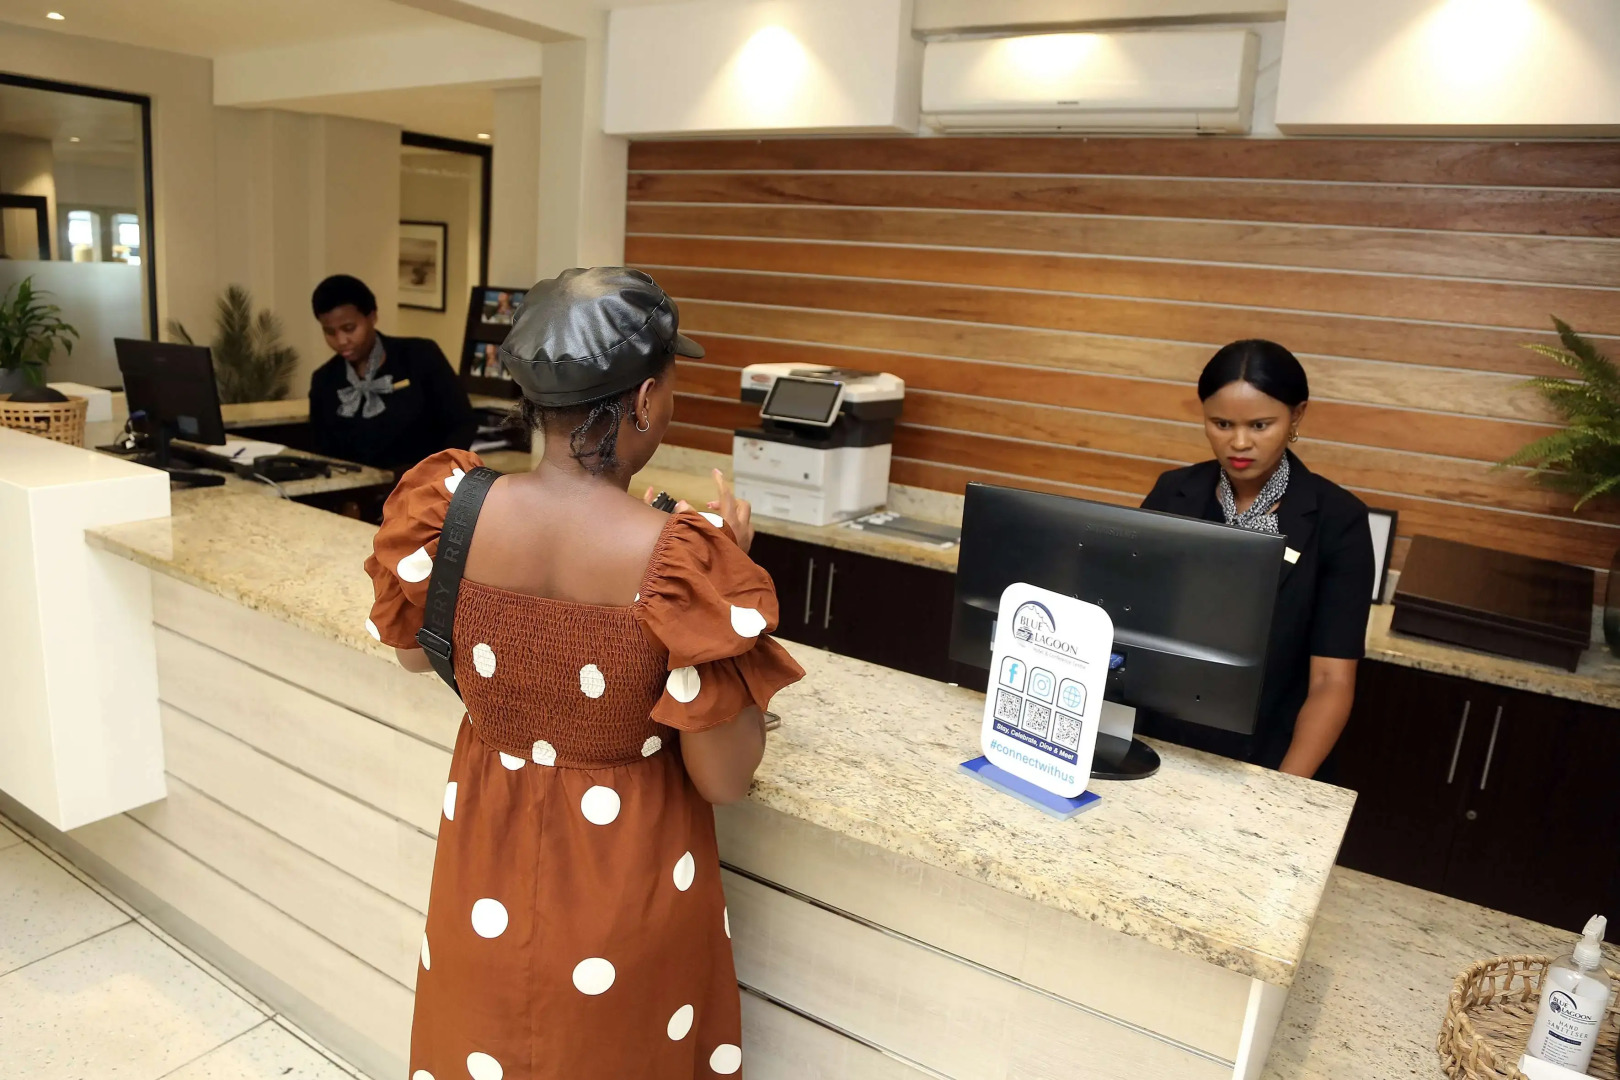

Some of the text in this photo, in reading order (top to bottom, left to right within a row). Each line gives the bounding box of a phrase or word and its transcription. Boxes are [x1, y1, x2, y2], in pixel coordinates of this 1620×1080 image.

[444, 468, 493, 564] REFINE
[1020, 615, 1043, 631] BLUE
[1034, 632, 1079, 655] LAGOON
[996, 723, 1010, 734] Stay,
[1010, 729, 1038, 747] Celebrate,
[1039, 741, 1053, 752] Dine
[1059, 750, 1075, 761] Meet
[990, 739, 1075, 785] #connectwithus
[1553, 996, 1568, 1008] BLUE
[1561, 1007, 1592, 1020] LAGOON
[1547, 1019, 1589, 1039] SANITISER
[1559, 1020, 1579, 1032] HAND
